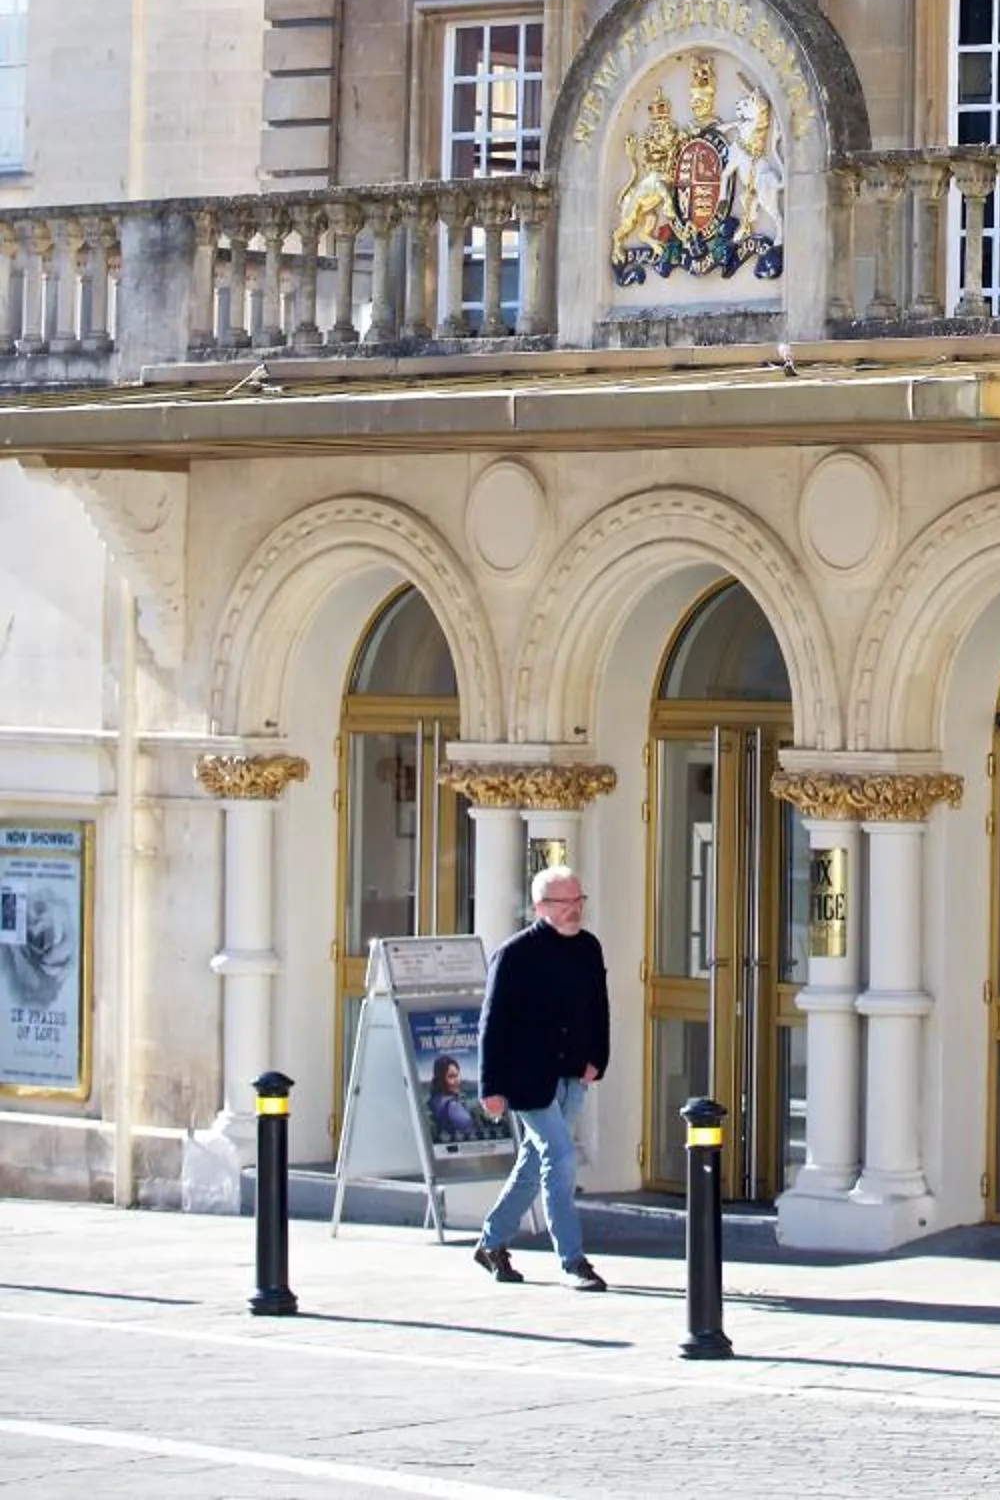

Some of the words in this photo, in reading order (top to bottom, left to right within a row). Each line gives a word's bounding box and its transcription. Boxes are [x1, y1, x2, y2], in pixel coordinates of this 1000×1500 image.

[574, 52, 620, 144] NEW
[751, 18, 816, 140] ROYAL
[6, 831, 27, 845] NOW
[31, 831, 75, 846] SHOWING
